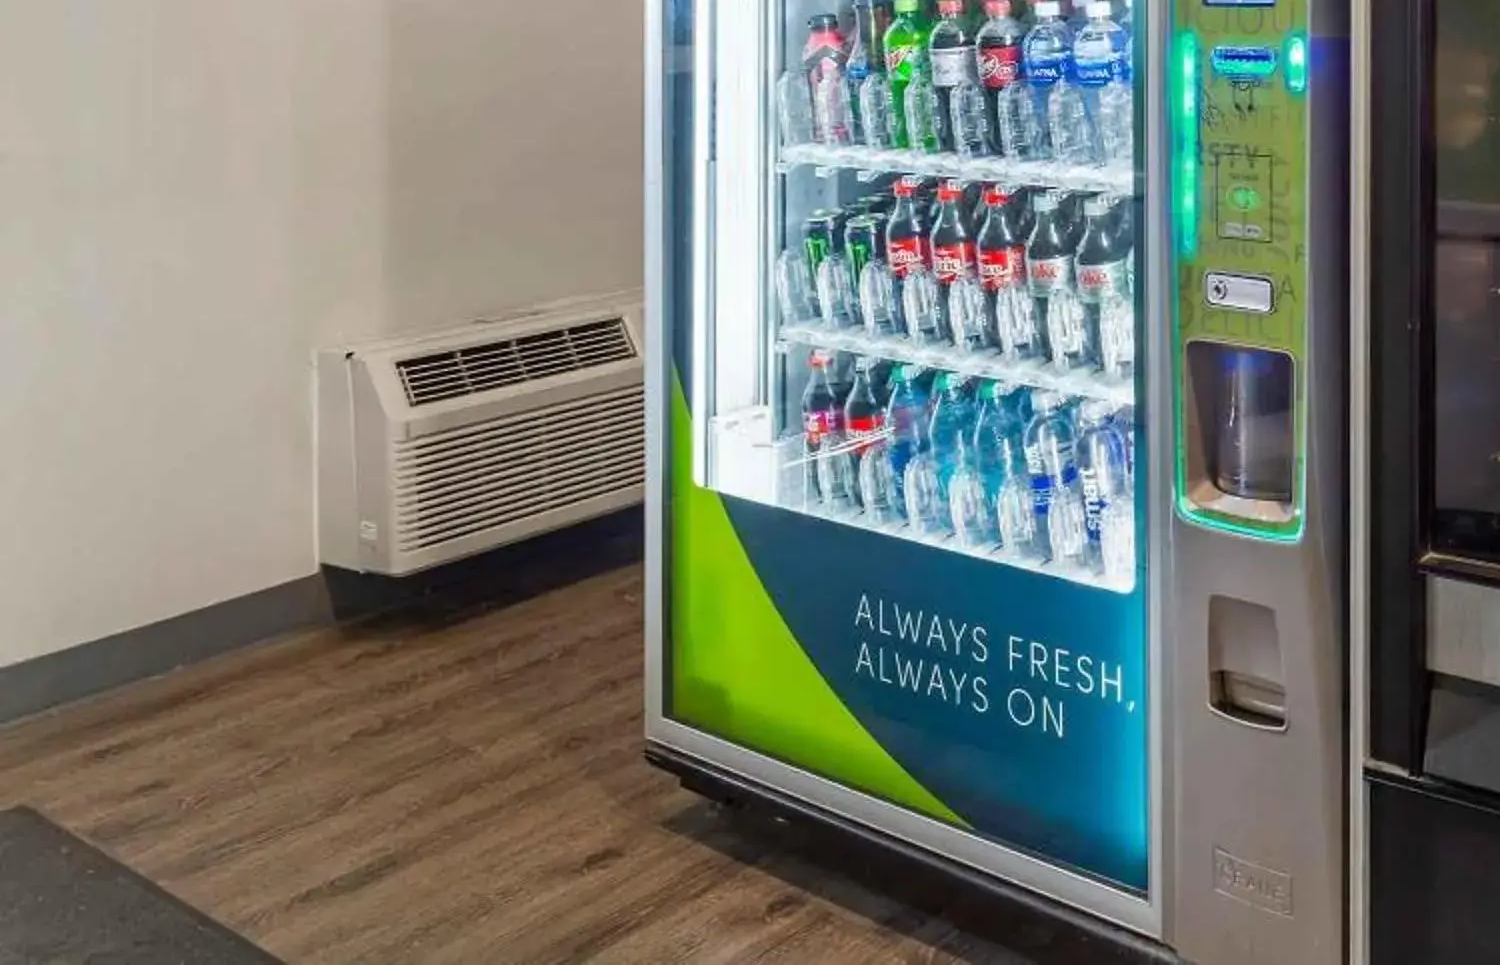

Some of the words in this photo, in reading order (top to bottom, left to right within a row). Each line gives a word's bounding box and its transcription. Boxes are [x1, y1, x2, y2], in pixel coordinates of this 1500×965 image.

[855, 593, 989, 663] ALWAYS
[1007, 634, 1136, 713] FRESH,
[855, 641, 989, 713] ALWAYS
[1007, 687, 1064, 738] ON
